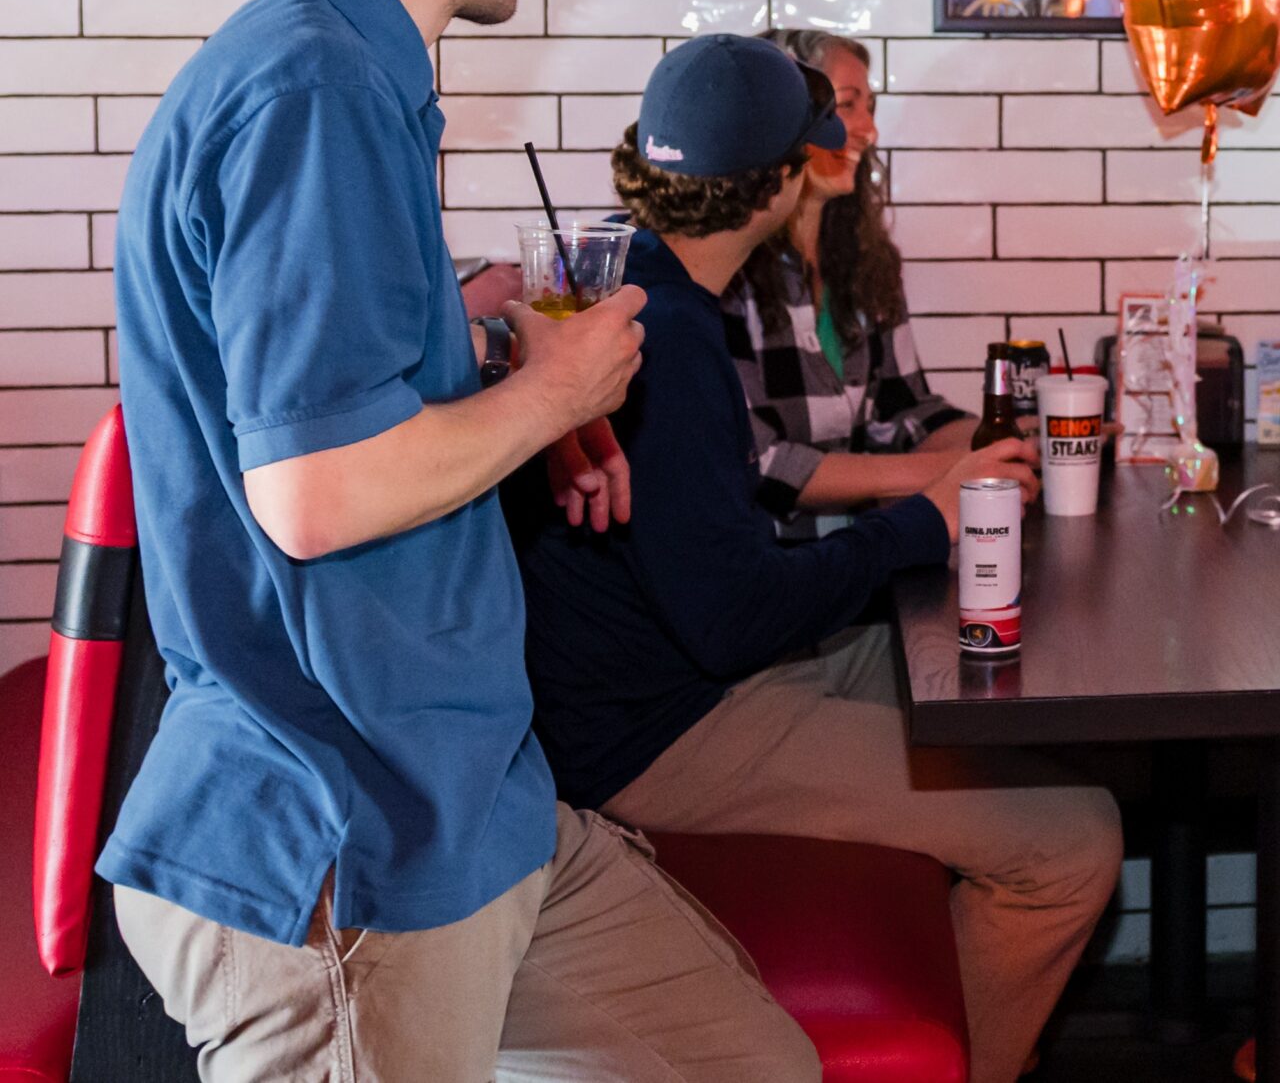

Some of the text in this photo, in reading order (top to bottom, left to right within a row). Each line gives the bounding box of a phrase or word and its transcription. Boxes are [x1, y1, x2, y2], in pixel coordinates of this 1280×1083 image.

[1049, 418, 1101, 436] GENO'S
[1052, 439, 1098, 456] STEAKS
[986, 526, 1009, 535] JUICE
